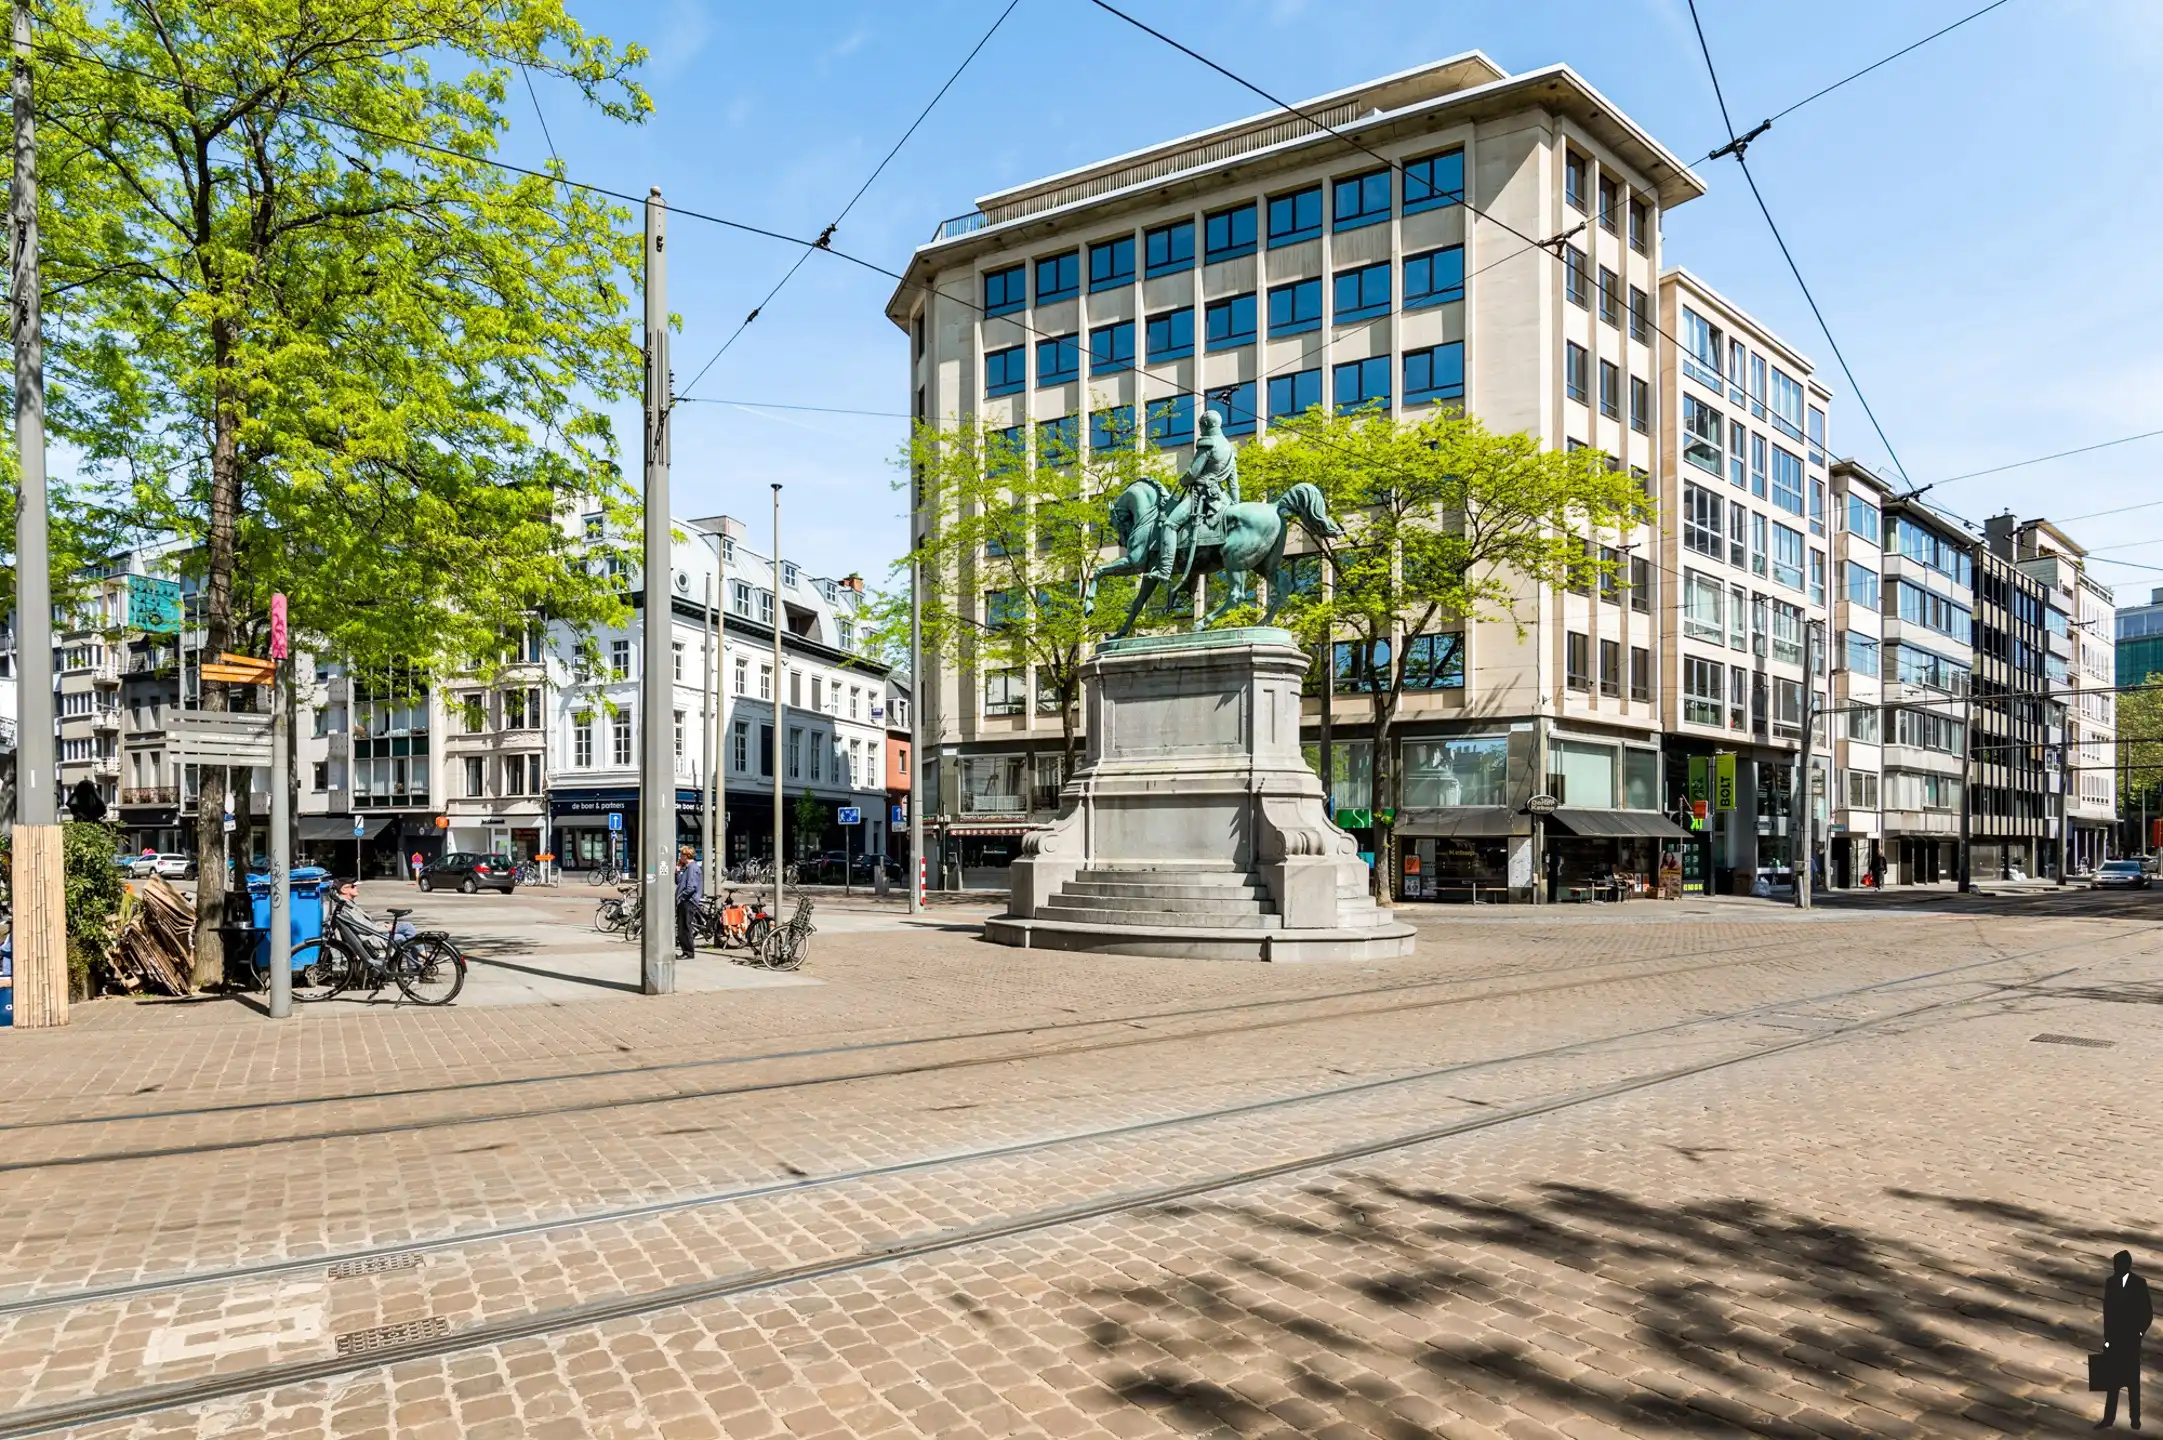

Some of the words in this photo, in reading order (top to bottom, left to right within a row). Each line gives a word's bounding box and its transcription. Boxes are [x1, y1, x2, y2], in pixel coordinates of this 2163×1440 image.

[1720, 776, 1731, 807] BOLT
[571, 802, 580, 810] de
[601, 802, 625, 810] partners
